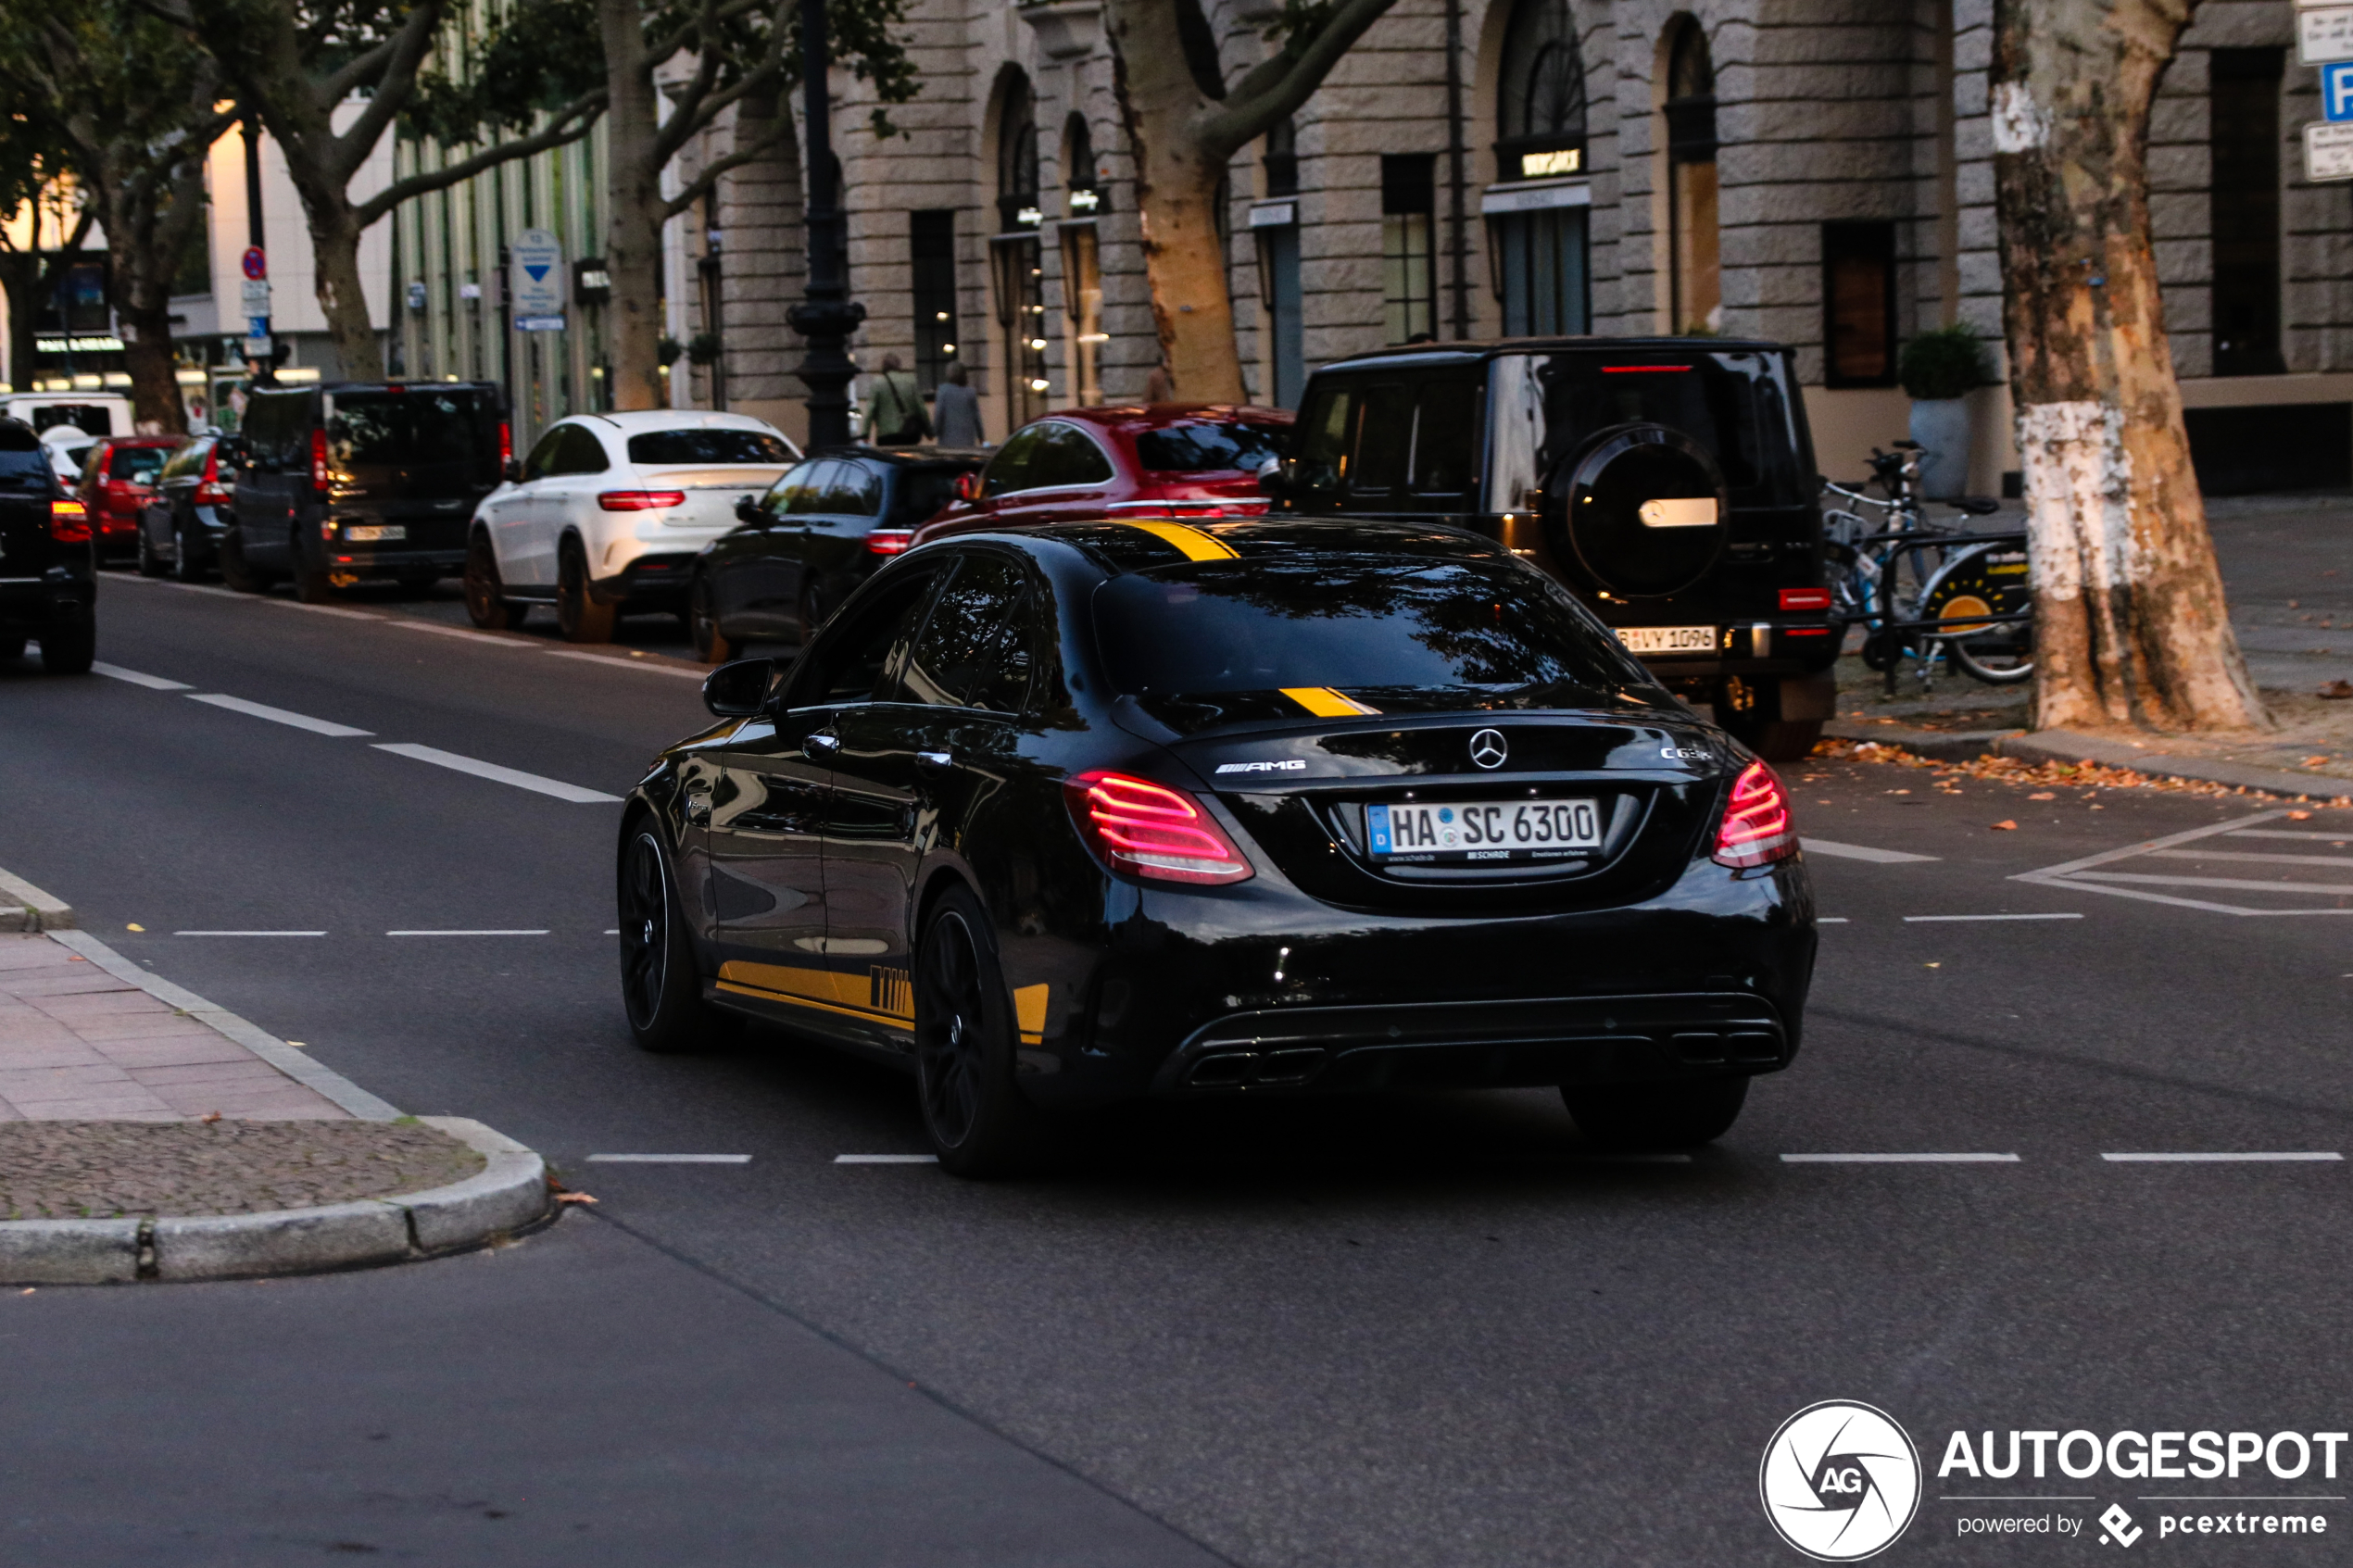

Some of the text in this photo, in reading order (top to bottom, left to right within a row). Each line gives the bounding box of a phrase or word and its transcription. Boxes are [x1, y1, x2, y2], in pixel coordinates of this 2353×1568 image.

[1669, 629, 1712, 647] 1096
[1245, 759, 1306, 771] AMG
[1376, 804, 1594, 847] D HA SC 6300
